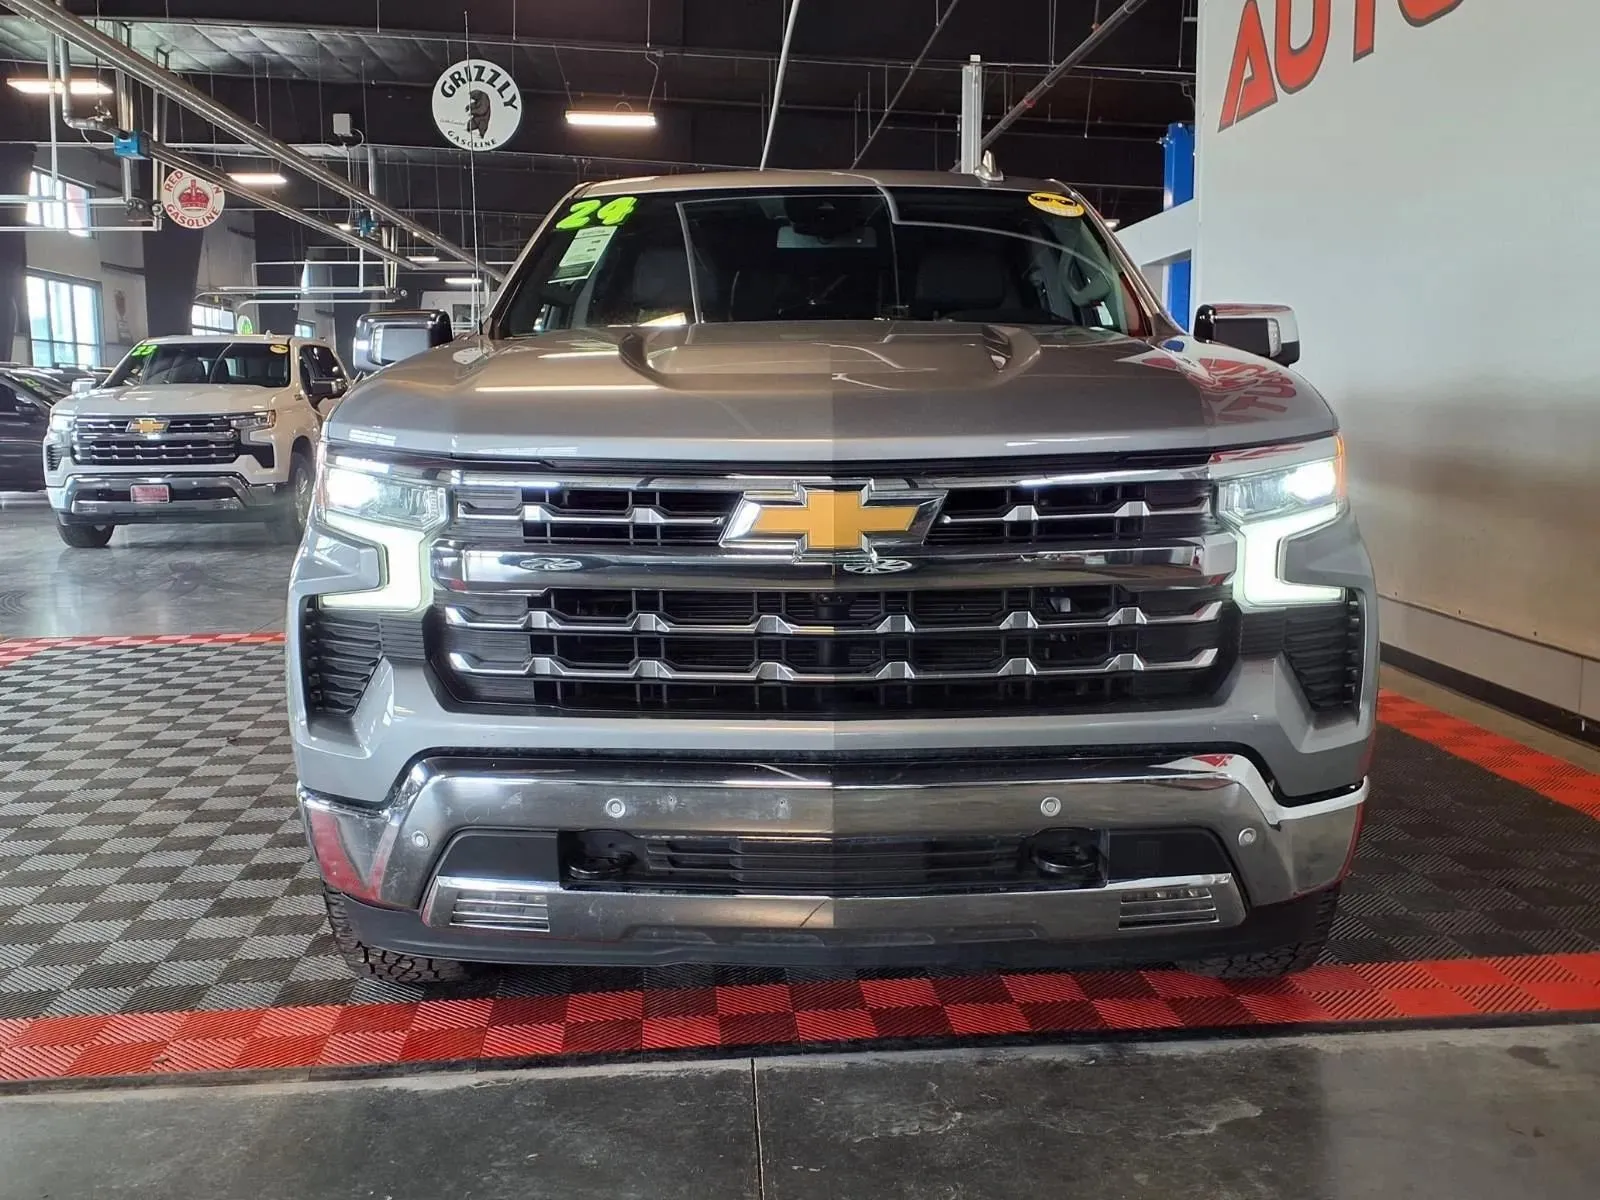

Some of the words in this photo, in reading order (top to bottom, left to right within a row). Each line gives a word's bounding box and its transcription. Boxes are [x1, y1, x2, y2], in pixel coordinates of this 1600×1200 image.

[1217, 0, 1465, 133] AU
[441, 65, 518, 110] GRIZZLY
[447, 130, 497, 148] GASOLINE
[164, 170, 184, 192] RED
[166, 203, 221, 227] GASOLINE
[555, 197, 638, 230] 24
